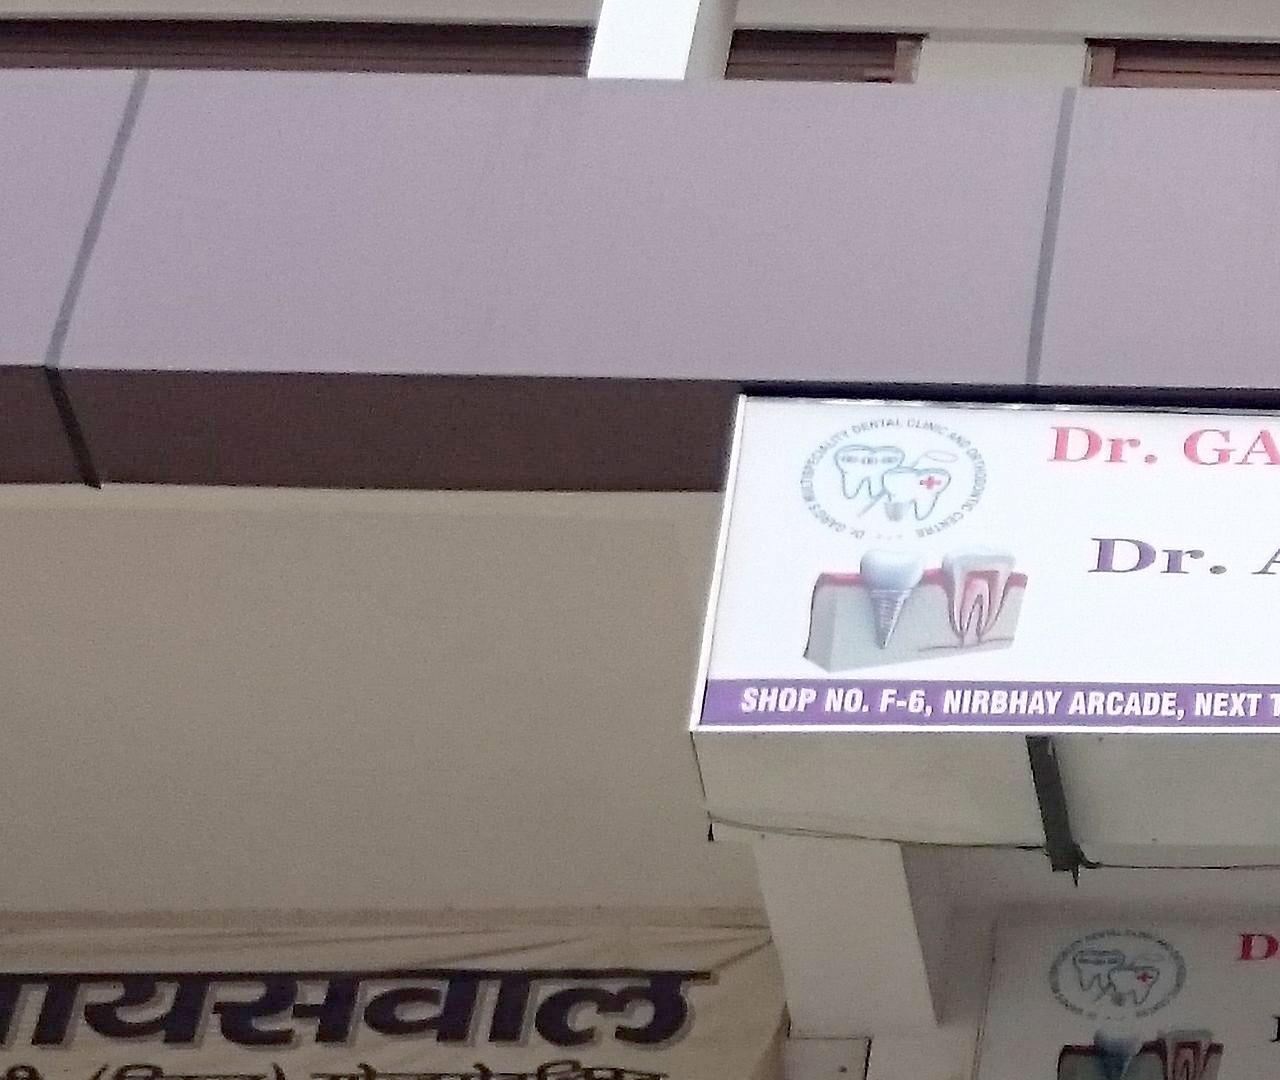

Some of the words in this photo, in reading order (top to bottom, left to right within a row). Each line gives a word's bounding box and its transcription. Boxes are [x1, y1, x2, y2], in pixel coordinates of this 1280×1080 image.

[1048, 426, 1157, 464] Dr.
[1088, 537, 1227, 575] Dr.
[740, 687, 816, 714] SHOP
[824, 688, 870, 714] NO.
[878, 689, 933, 718] F-6,
[942, 690, 1062, 716] NIRBHAY
[1068, 691, 1186, 720] ARCADE,
[1194, 693, 1263, 718] NEXT
[0, 969, 712, 1048] ायसवाल
